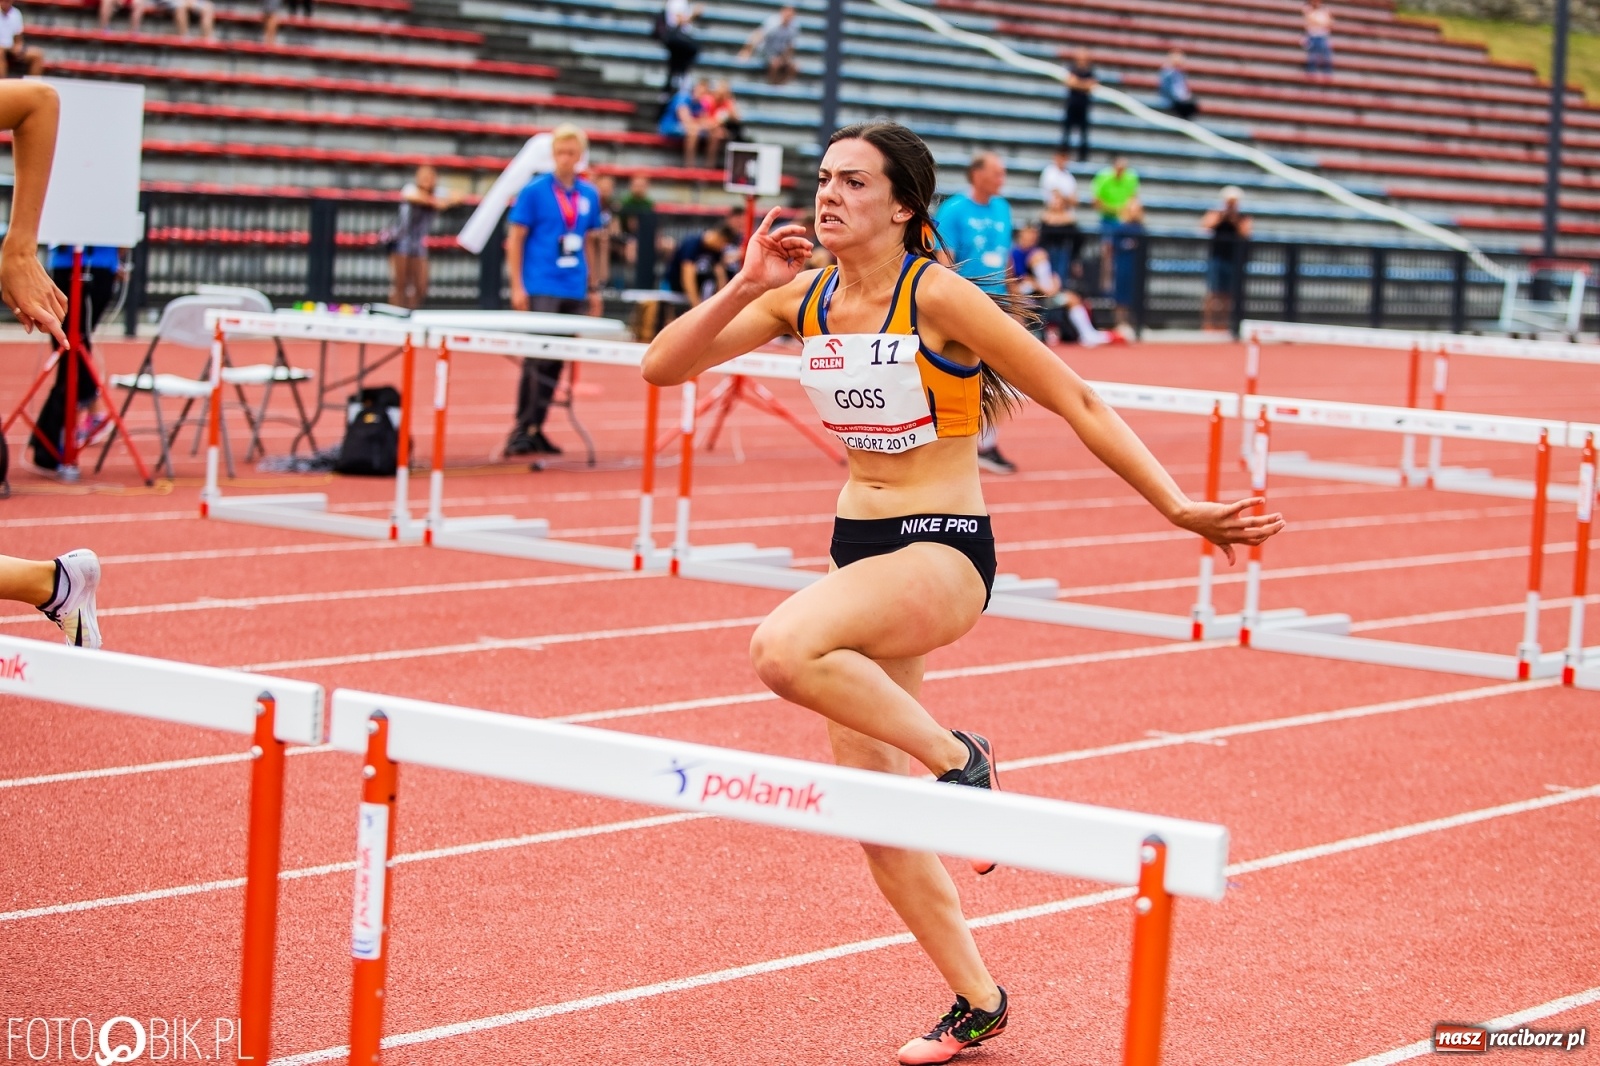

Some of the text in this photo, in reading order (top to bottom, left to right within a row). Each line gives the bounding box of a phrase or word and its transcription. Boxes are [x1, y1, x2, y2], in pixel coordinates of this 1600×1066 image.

[870, 339, 900, 365] 11
[811, 357, 843, 369] ORLEN
[834, 388, 886, 409] GOSS
[836, 433, 917, 450] CIBÓRZ 2019
[900, 518, 978, 535] NIKE PRO
[701, 773, 825, 814] polanik
